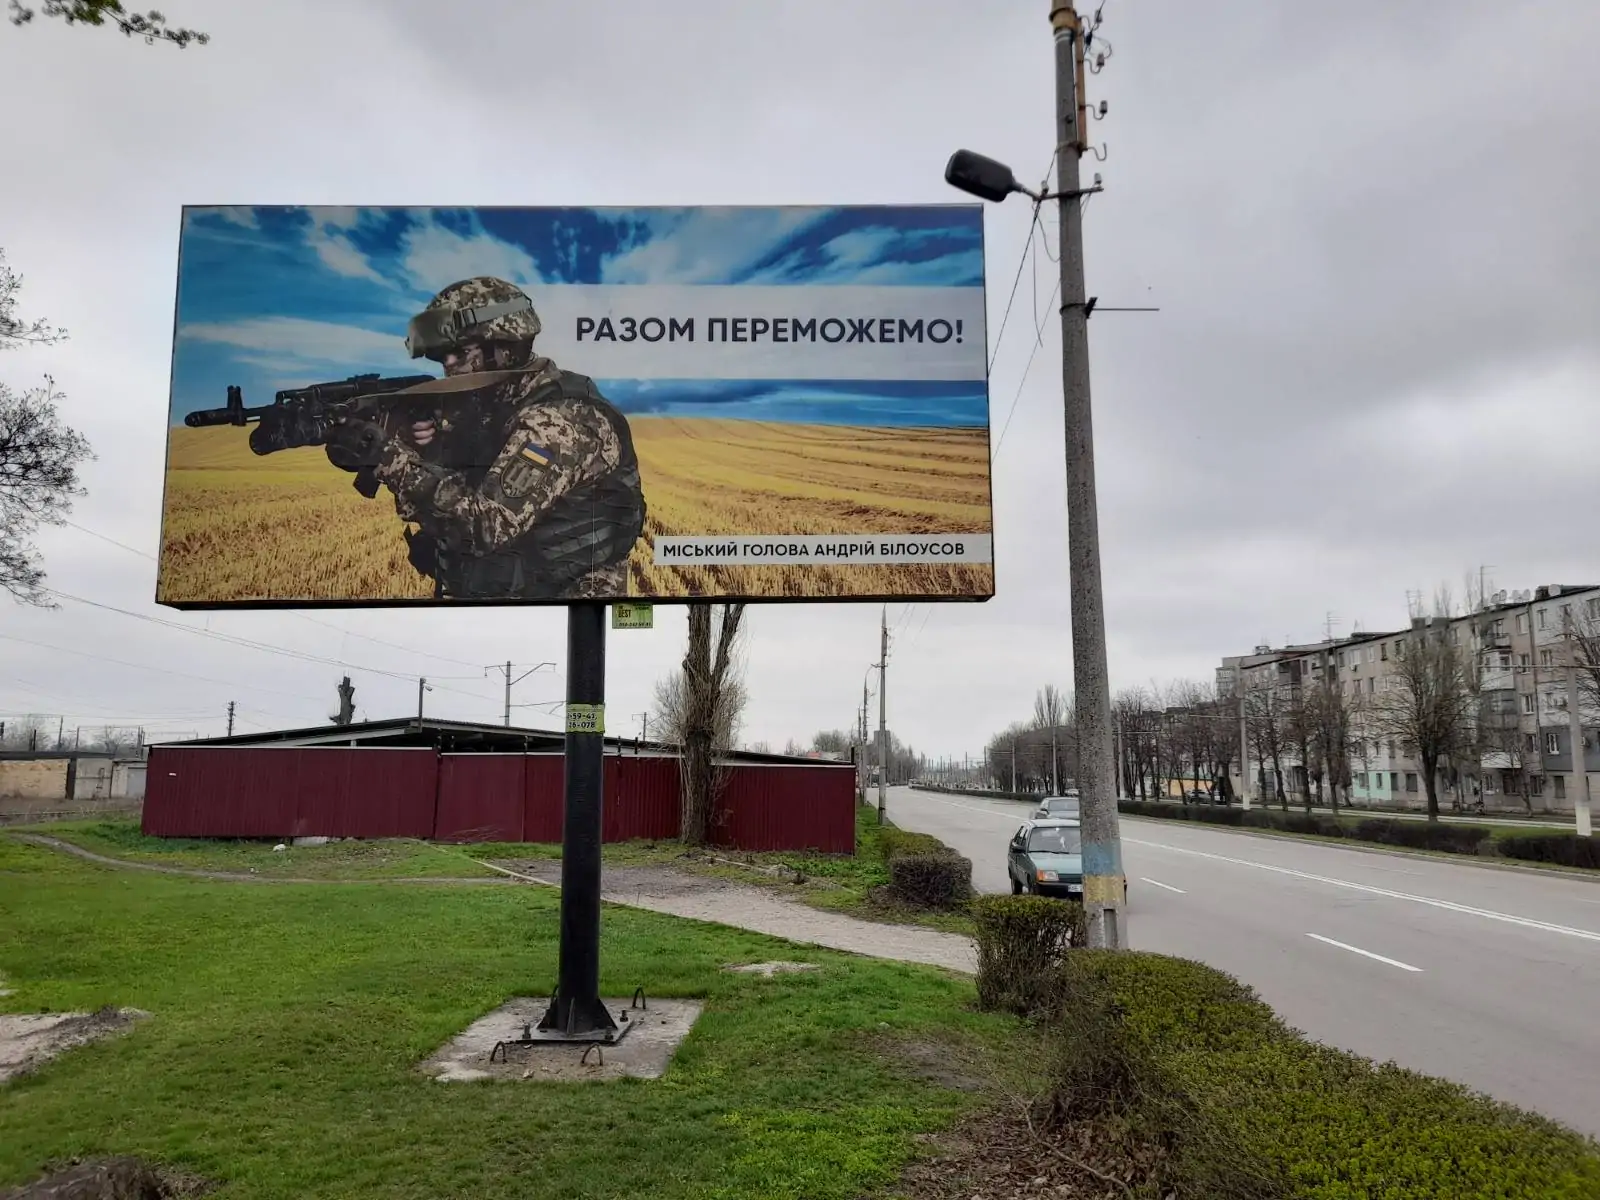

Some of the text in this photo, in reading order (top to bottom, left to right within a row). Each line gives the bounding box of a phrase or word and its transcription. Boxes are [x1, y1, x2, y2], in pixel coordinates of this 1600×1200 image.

[576, 317, 963, 344] РАЗОМ ПЕРЕМОЖЕМО!
[663, 541, 965, 557] МІСЬКИЙ ГОЛОВА АНДРІЙ БІЛОУСОВ
